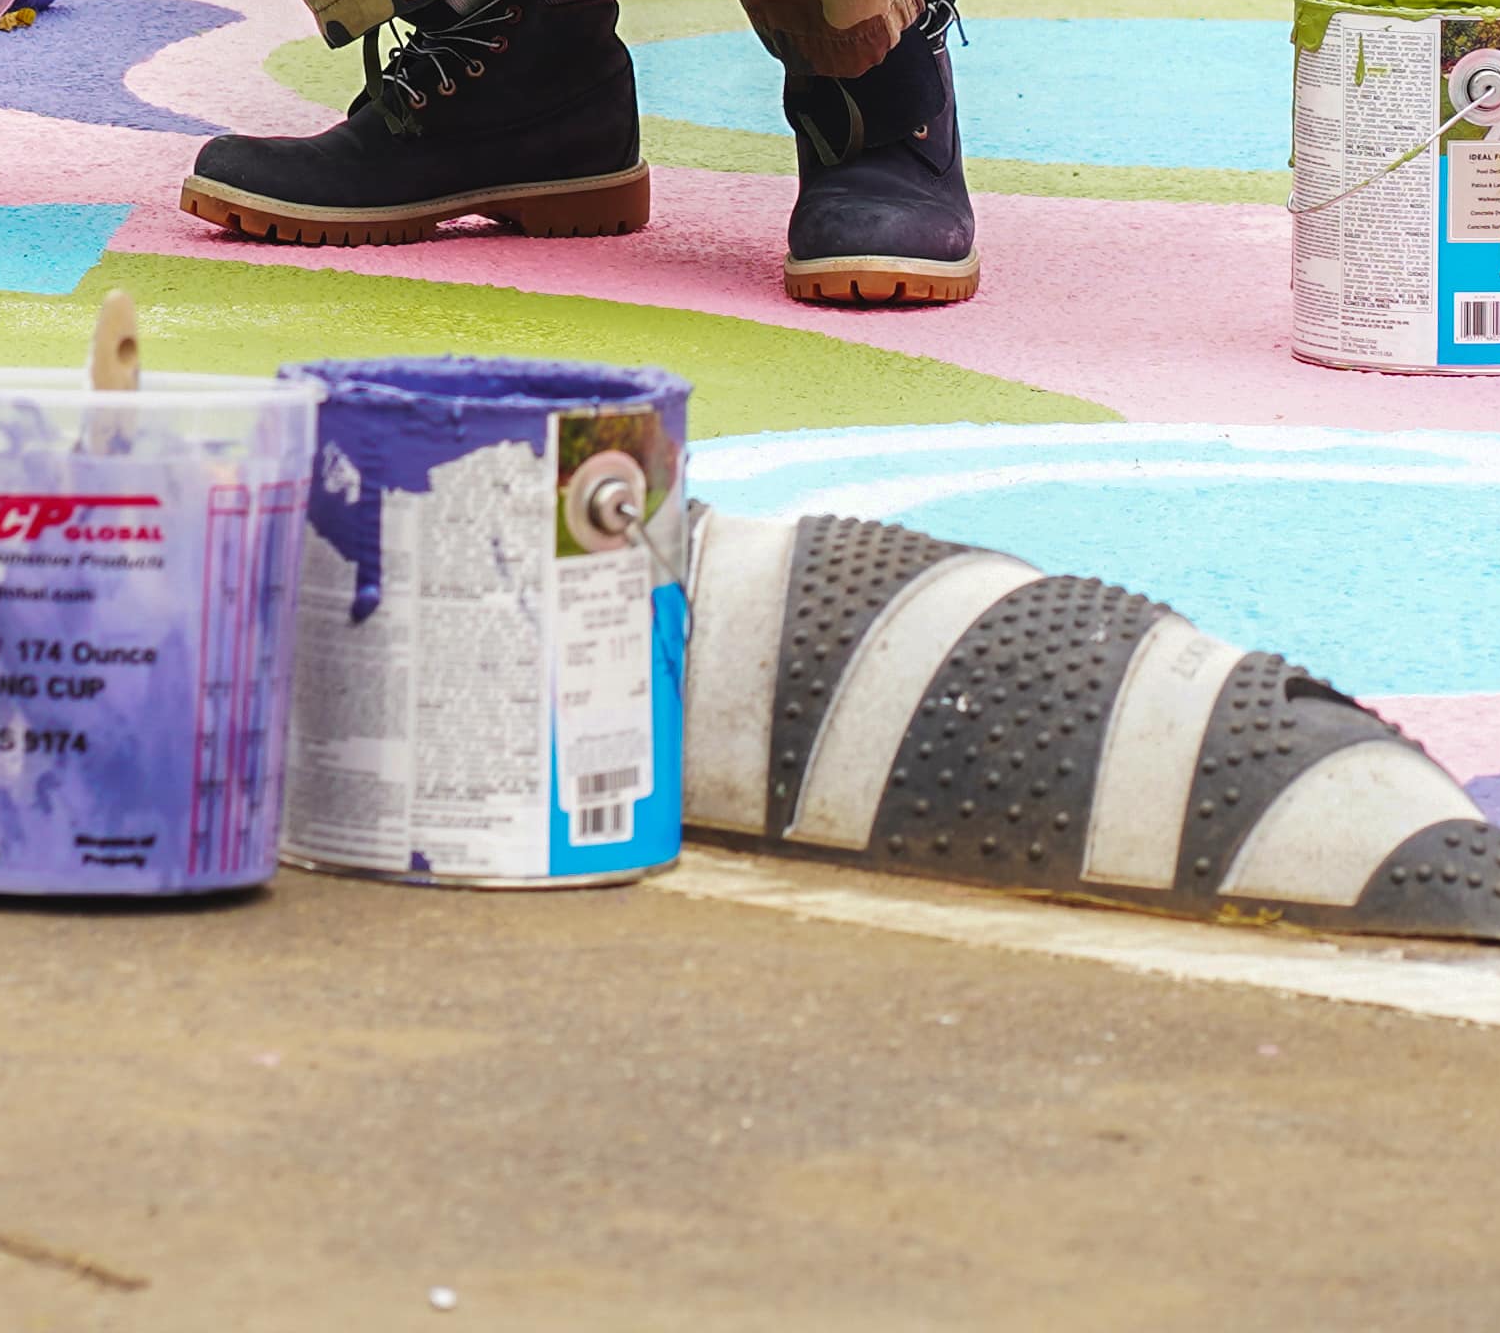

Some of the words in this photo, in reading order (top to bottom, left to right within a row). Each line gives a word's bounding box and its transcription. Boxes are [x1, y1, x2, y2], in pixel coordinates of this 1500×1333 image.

[1469, 153, 1492, 161] IDEAL
[63, 525, 164, 542] GLOBAL
[17, 639, 62, 663] 174
[72, 641, 158, 665] Ounce
[47, 676, 106, 700] CUP
